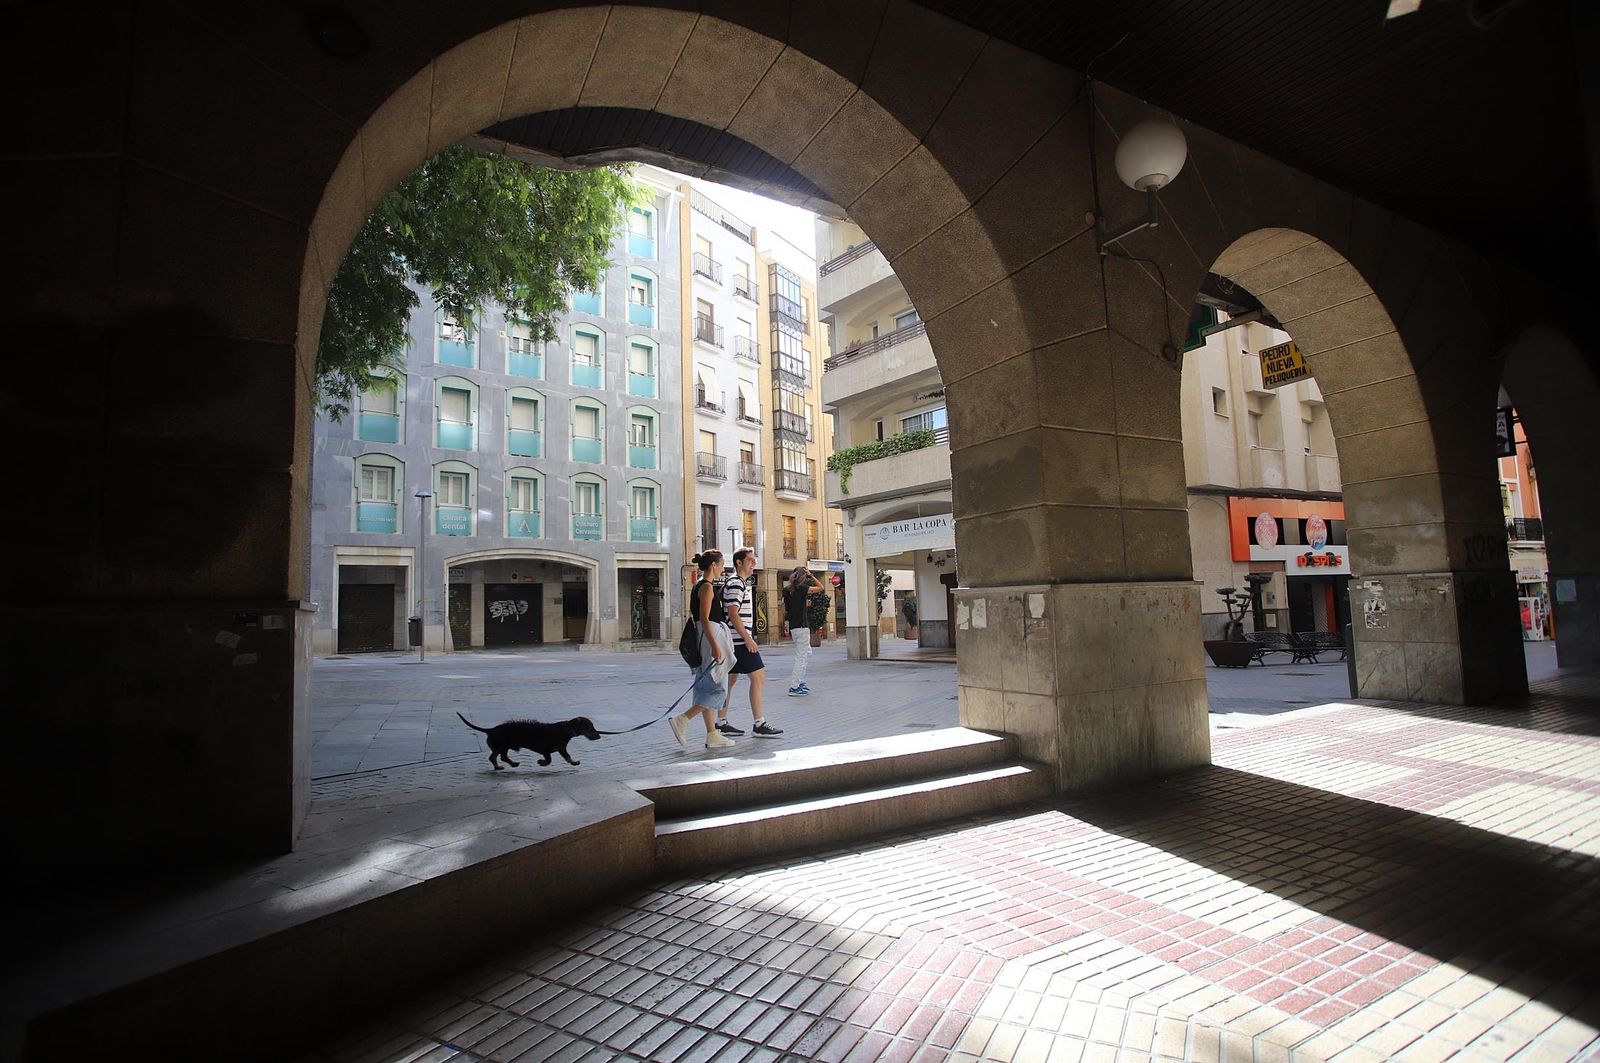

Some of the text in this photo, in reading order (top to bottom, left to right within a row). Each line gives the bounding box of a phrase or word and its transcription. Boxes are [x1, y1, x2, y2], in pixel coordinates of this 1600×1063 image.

[1262, 344, 1290, 362] PEDRO
[1267, 356, 1295, 374] NUEVA
[1265, 366, 1307, 386] PELUQUERIA
[442, 522, 466, 530] dental
[893, 524, 910, 534] BAR
[913, 522, 924, 531] LA
[925, 518, 947, 528] COPA
